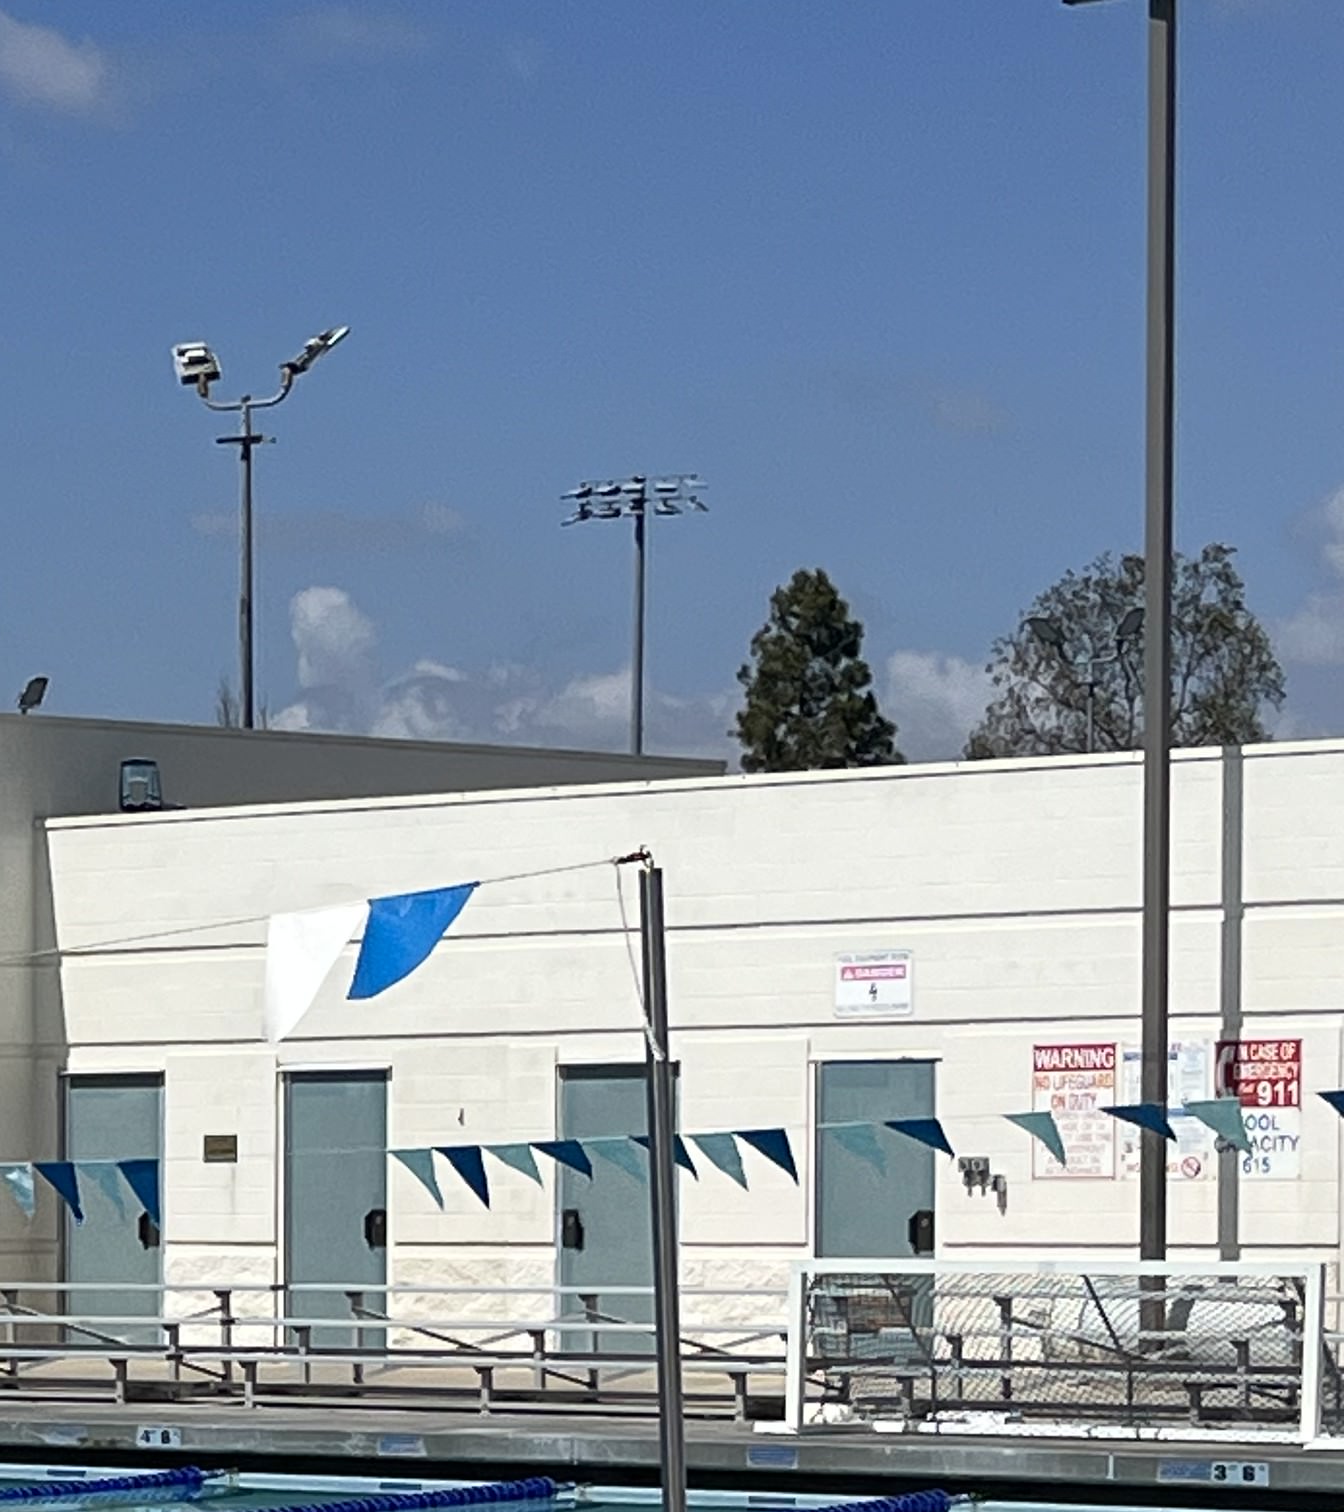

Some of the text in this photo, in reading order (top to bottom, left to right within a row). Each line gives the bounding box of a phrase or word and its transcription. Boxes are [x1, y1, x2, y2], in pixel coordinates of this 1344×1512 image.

[1034, 1047, 1114, 1069] WARNING
[1250, 1044, 1279, 1061] CASE
[1280, 1043, 1297, 1061] OF
[1256, 1080, 1299, 1106] 911
[1244, 1114, 1280, 1131] OOL
[1242, 1156, 1271, 1173] 615
